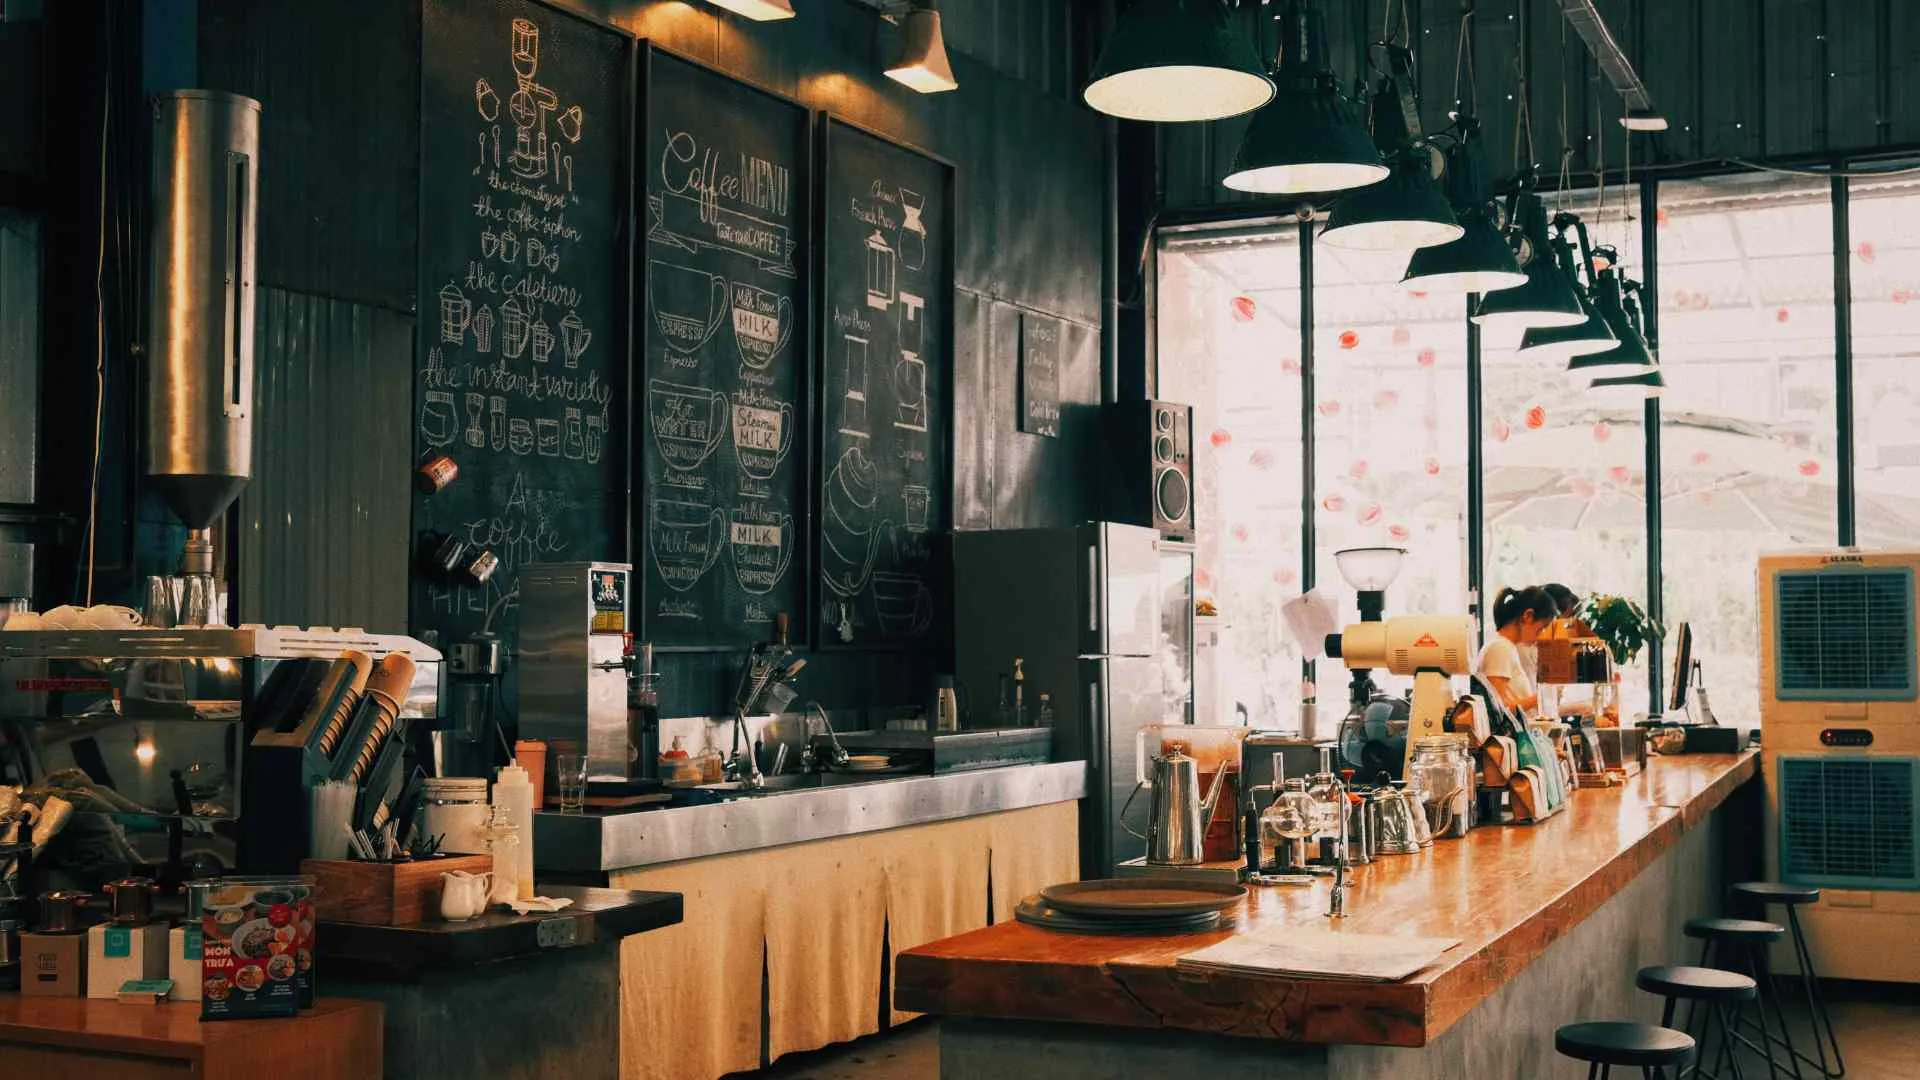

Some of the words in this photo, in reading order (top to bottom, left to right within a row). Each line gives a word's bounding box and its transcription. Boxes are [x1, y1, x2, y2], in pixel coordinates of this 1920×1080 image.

[662, 127, 739, 226] Coffee
[740, 151, 789, 217] MENU
[472, 195, 504, 221] the
[464, 260, 499, 293] the
[737, 313, 773, 338] MILK
[420, 346, 461, 390] the
[739, 429, 775, 451] MILK
[737, 527, 774, 545] MILK
